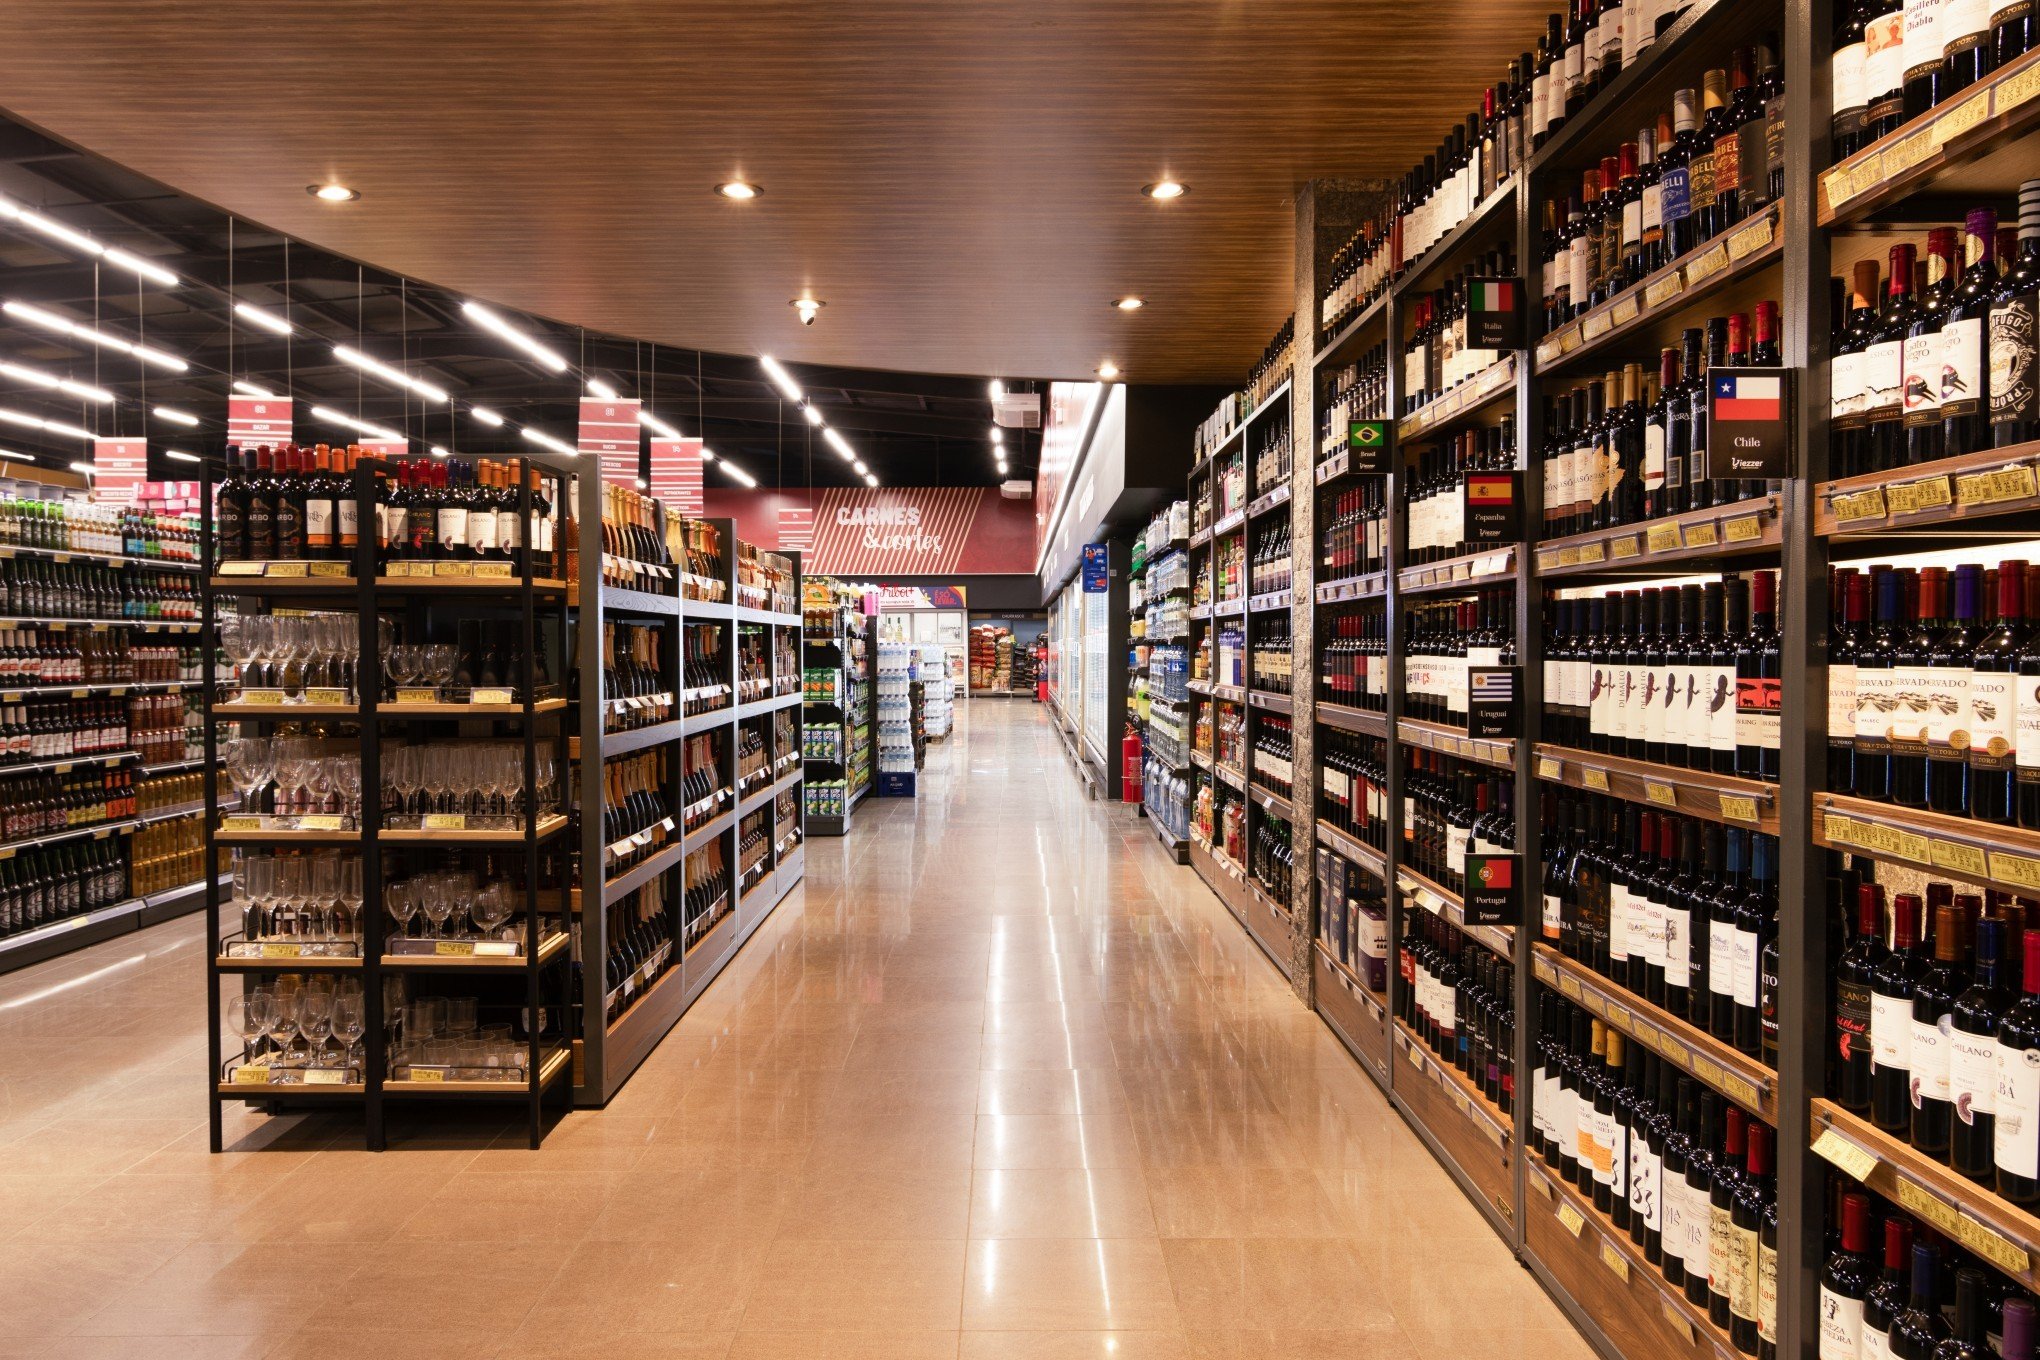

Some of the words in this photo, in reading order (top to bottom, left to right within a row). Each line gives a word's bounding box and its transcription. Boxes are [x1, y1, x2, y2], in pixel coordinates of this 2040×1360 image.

[2006, 3, 2031, 15] TORO
[1906, 15, 1934, 33] Diablo
[1956, 35, 1978, 47] TORO
[1991, 316, 2022, 329] ÓFUGO
[254, 404, 266, 414] 02
[605, 407, 615, 417] 01
[1733, 436, 1761, 448] Chile
[1731, 457, 1764, 470] Viezzer
[837, 506, 920, 526] CARNES
[1474, 513, 1506, 522] Espanha
[1857, 677, 1893, 687] SERVAD
[1929, 679, 1967, 688] RVADO
[1480, 710, 1507, 719] Uruguai
[1475, 896, 1506, 905] Portugal
